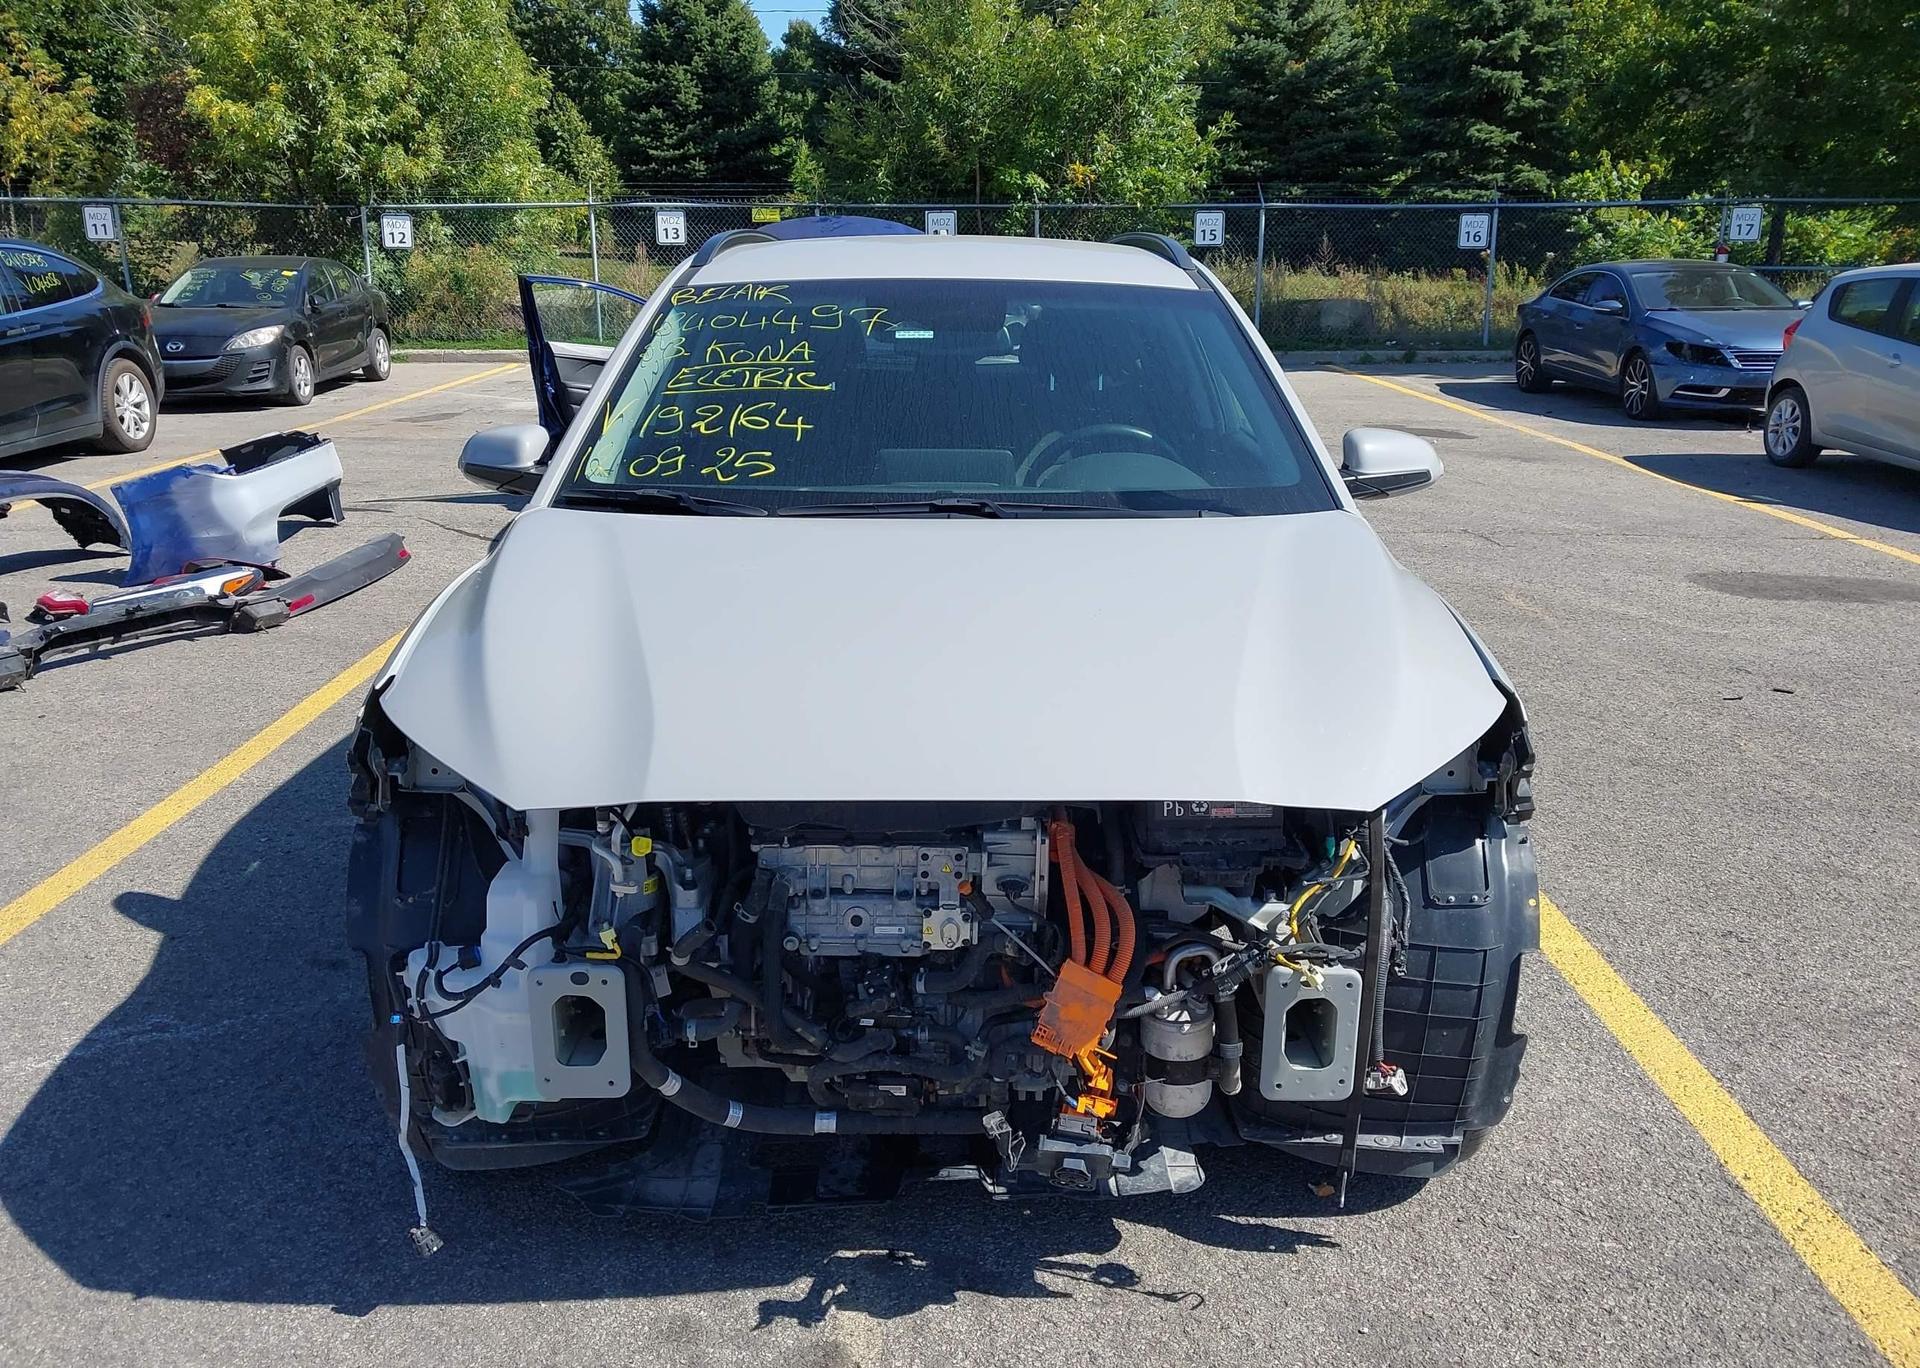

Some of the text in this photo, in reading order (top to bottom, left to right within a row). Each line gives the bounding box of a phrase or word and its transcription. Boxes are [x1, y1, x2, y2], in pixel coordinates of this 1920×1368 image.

[88, 212, 108, 221] MDZ
[660, 216, 681, 225] MDZ
[931, 217, 951, 227] MDZ
[1199, 218, 1219, 227] MDZ
[1735, 213, 1757, 221] MDZ
[91, 223, 108, 236] 11
[385, 220, 407, 229] MDZ
[1464, 220, 1484, 229] MDZ
[1736, 223, 1755, 236] 17
[388, 231, 407, 244] 12
[662, 227, 680, 240] 13
[1200, 229, 1217, 242] 15
[1464, 230, 1482, 243] 16
[705, 338, 816, 364] KONA
[1163, 801, 1184, 817] Pb
